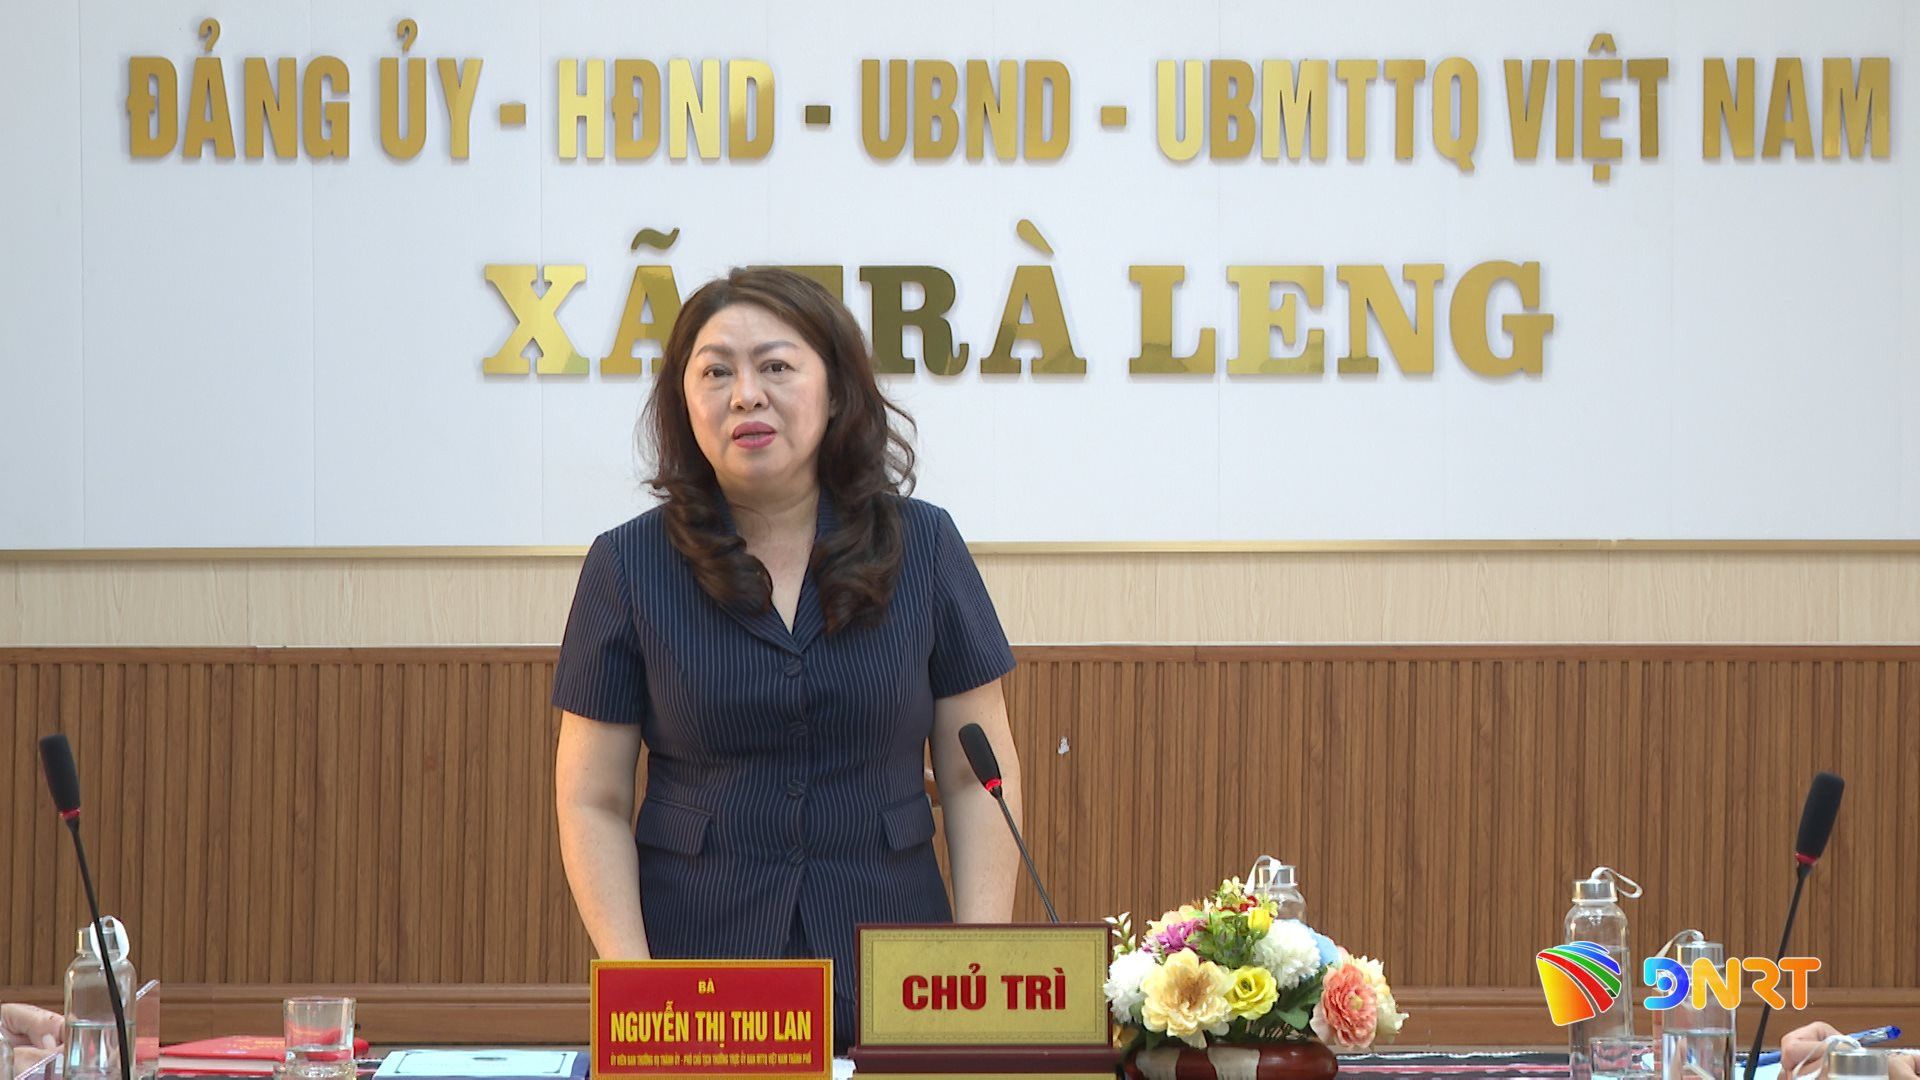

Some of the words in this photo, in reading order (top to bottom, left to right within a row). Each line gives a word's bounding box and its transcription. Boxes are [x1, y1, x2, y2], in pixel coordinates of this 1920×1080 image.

[127, 17, 350, 158] ĐẢNG
[379, 17, 483, 158] ỦY
[500, 103, 526, 126] -
[557, 58, 775, 159] HĐND
[805, 105, 831, 125] -
[861, 59, 1071, 160] UBND
[1101, 106, 1127, 126] -
[1156, 57, 1480, 171] UBMTTQ
[1503, 33, 1668, 182] VIỆT
[1702, 57, 1891, 159] NAM
[483, 227, 682, 375] XÃ
[747, 218, 1087, 376] RÀ
[1128, 260, 1555, 375] LENG
[698, 978, 715, 994] BÀ
[902, 963, 987, 1011] CHỦ
[1001, 967, 1066, 1010] TRÌ
[610, 1000, 690, 1042] NGUYỄN
[695, 1011, 725, 1048] THỊ
[731, 1011, 768, 1042] THU
[774, 1011, 812, 1042] LAN
